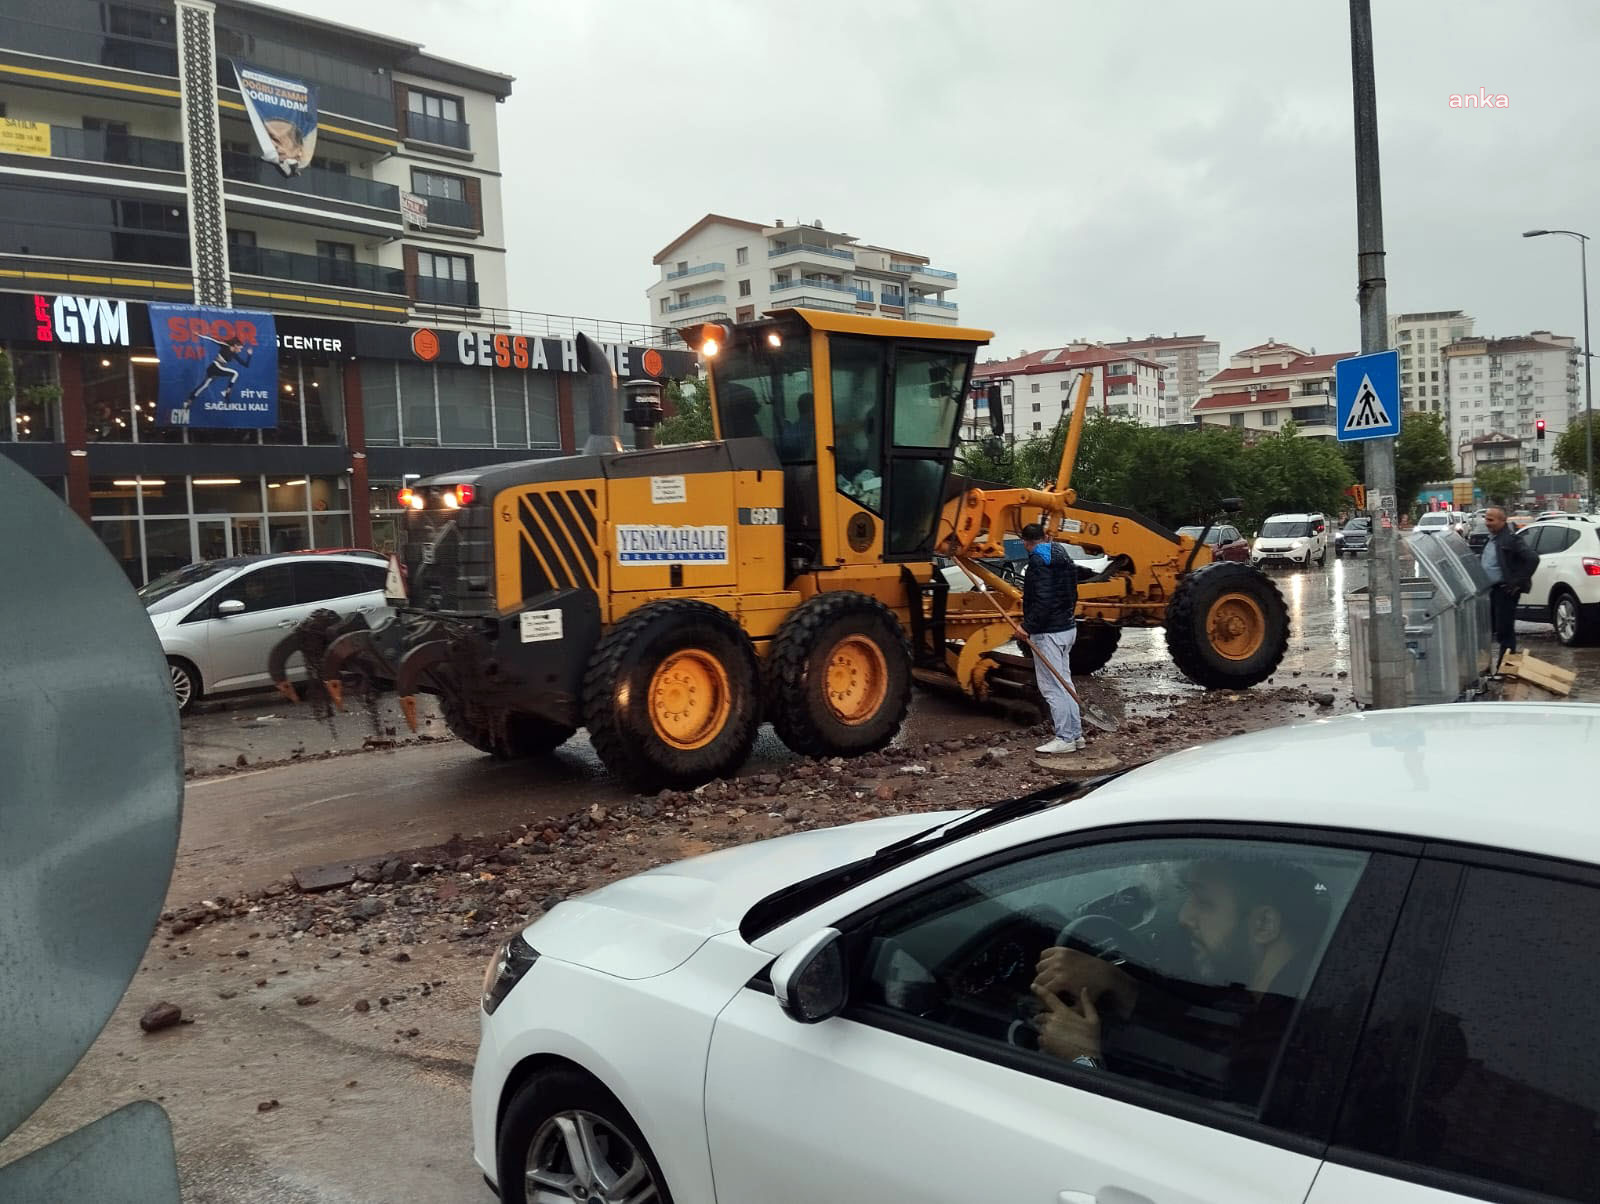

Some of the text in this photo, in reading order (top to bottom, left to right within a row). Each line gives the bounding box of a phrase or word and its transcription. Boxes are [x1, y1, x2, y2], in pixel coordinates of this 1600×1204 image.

[280, 99, 308, 112] ADAM
[54, 296, 130, 346] GYM
[168, 316, 258, 346] SPOR
[284, 335, 342, 353] CENTER
[457, 331, 630, 376] CESSA HME
[256, 391, 268, 399] VE
[171, 409, 191, 424] GYM
[1112, 521, 1120, 535] 6
